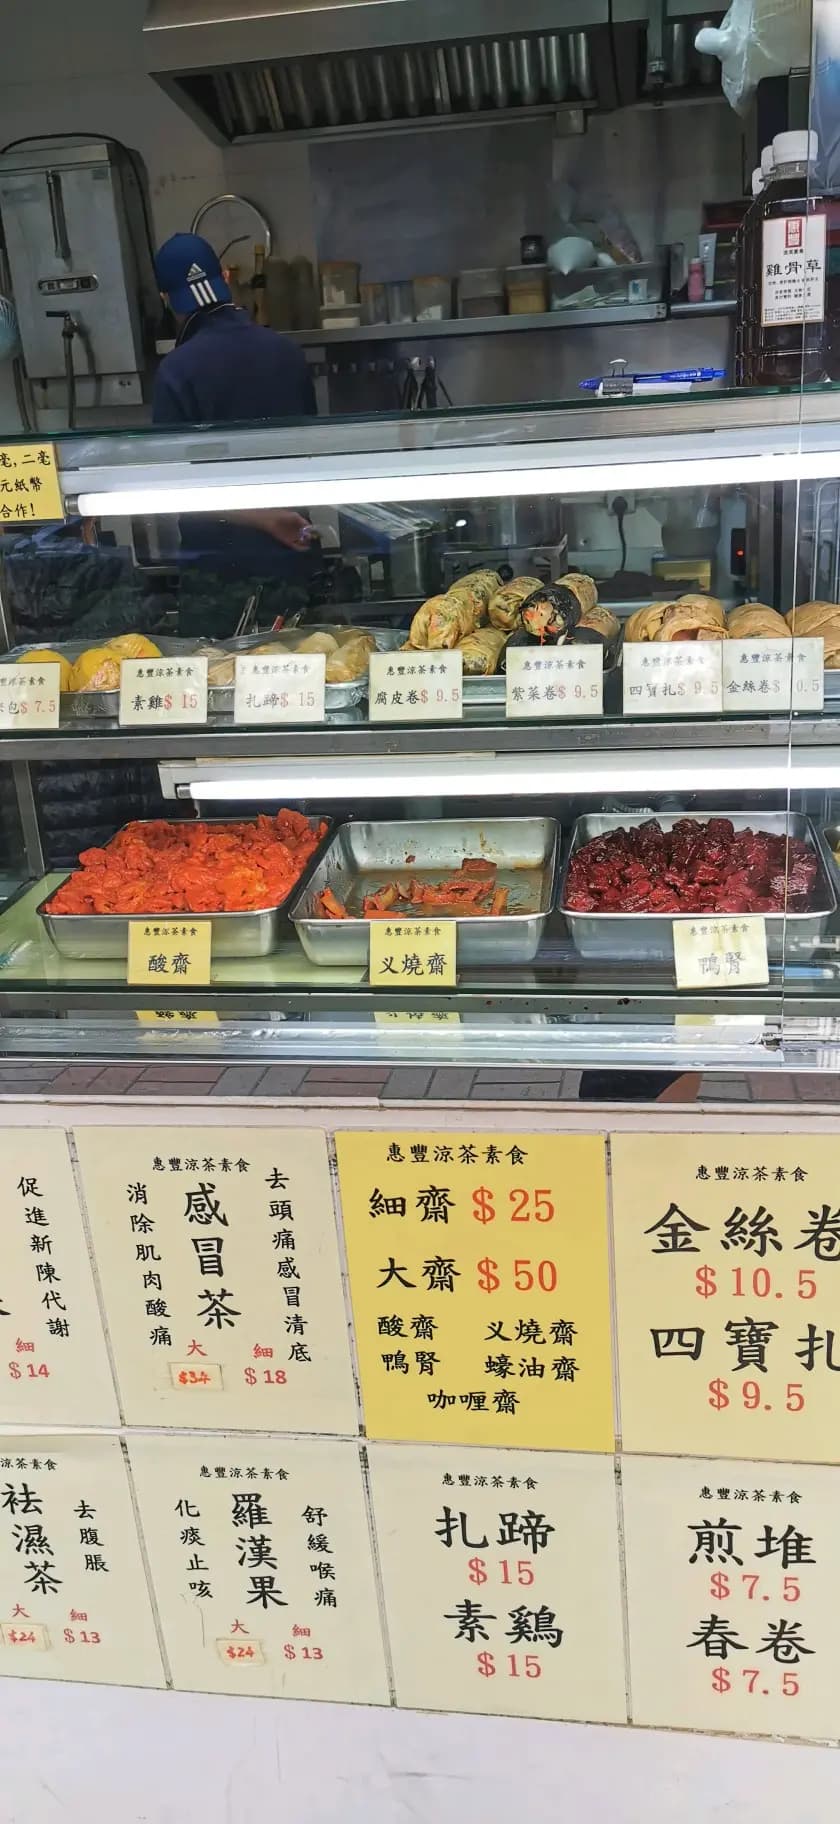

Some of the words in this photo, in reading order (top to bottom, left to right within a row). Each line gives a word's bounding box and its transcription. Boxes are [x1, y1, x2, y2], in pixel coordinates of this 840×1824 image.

[766, 259, 822, 277] 雞骨草
[0, 476, 43, 493] 元紙幣
[375, 690, 420, 705] 腐皮卷
[511, 686, 557, 701] 紫菜卷
[727, 680, 770, 693] 金絲卷
[148, 953, 192, 975] 酸齋
[152, 1156, 251, 1173] 惠豐涼茶素食
[386, 1142, 529, 1166] 惠豐涼茶素食
[695, 1165, 809, 1182] 惠豐涼茶素食
[368, 1185, 456, 1225] 細齋
[643, 1202, 840, 1262] 金絲卷
[17, 1176, 70, 1338] 促進新陳代謝
[126, 1182, 173, 1347] 消除肌肉酸痛
[184, 1182, 242, 1330] 感冒茶
[264, 1167, 313, 1363] 去頭痛感冒清底
[376, 1255, 462, 1293] 大齋
[377, 1313, 439, 1342] 酸齋
[15, 1337, 36, 1353] 細
[187, 1339, 208, 1357] 大
[253, 1343, 274, 1360] 細
[650, 1315, 840, 1374] 四寶扎
[381, 1349, 441, 1377] 鴨腎
[484, 1353, 581, 1383] 蠔油齋
[427, 1388, 521, 1416] 咖喱齋
[199, 1465, 290, 1480] 惠豐涼茶素食
[441, 1472, 539, 1490] 惠豐涼茶素食
[699, 1485, 803, 1504] 惠豐涼茶素食
[73, 1499, 110, 1573] 去腹脹
[434, 1505, 555, 1554] 扎蹄
[175, 1499, 214, 1599] 化痰止咳
[231, 1493, 289, 1610] 羅漢果
[687, 1517, 817, 1569] 煎堆
[301, 1505, 338, 1608] 舒緩喉痛
[12, 1603, 30, 1618] 大
[70, 1609, 88, 1621] 細
[230, 1618, 250, 1634] 大
[292, 1624, 311, 1637] 細
[686, 1613, 817, 1664] 春卷
